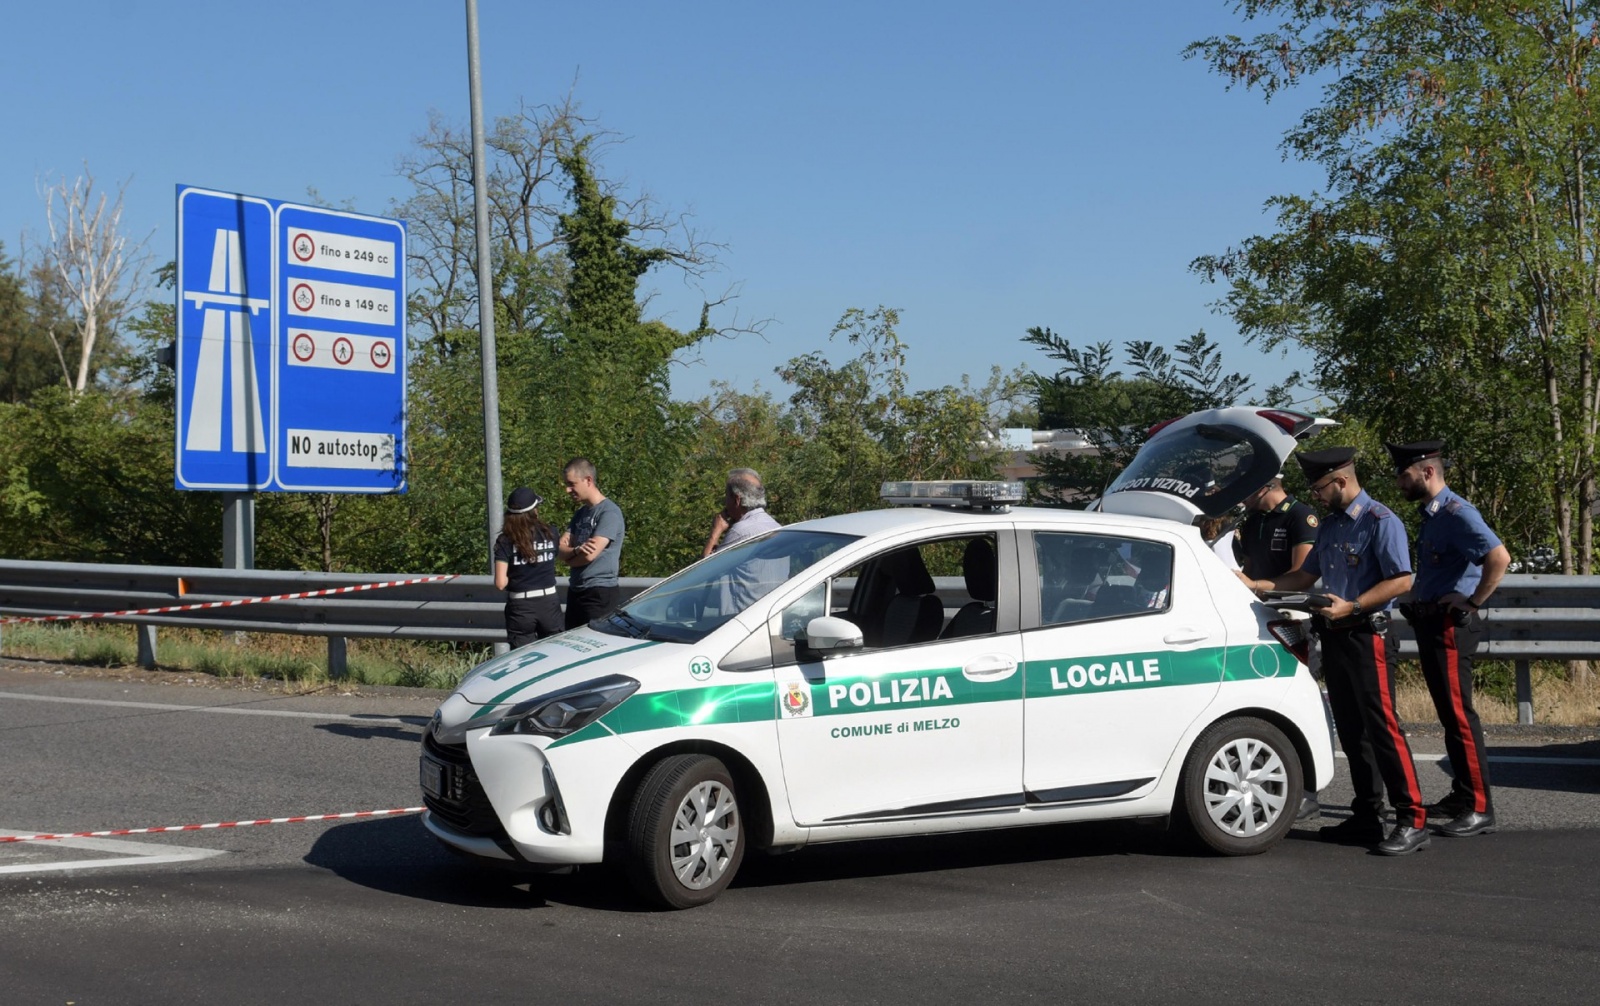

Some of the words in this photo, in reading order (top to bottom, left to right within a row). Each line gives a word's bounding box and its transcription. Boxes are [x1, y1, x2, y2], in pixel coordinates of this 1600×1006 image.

[320, 245, 341, 257] fino
[344, 250, 350, 258] a
[354, 249, 374, 262] 249
[377, 255, 388, 264] cc
[320, 294, 341, 307] fino
[344, 299, 350, 308] a
[356, 299, 374, 311] 149
[377, 303, 388, 312] cc
[291, 436, 311, 455] NO
[318, 438, 378, 462] autostop
[1150, 477, 1200, 498] POLIZIA
[691, 662, 711, 675] 03
[828, 675, 954, 709] POLIZIA
[1050, 658, 1161, 690] LOCALE
[830, 723, 893, 739] COMUNE
[897, 722, 909, 734] di
[913, 717, 961, 732] MELZO
